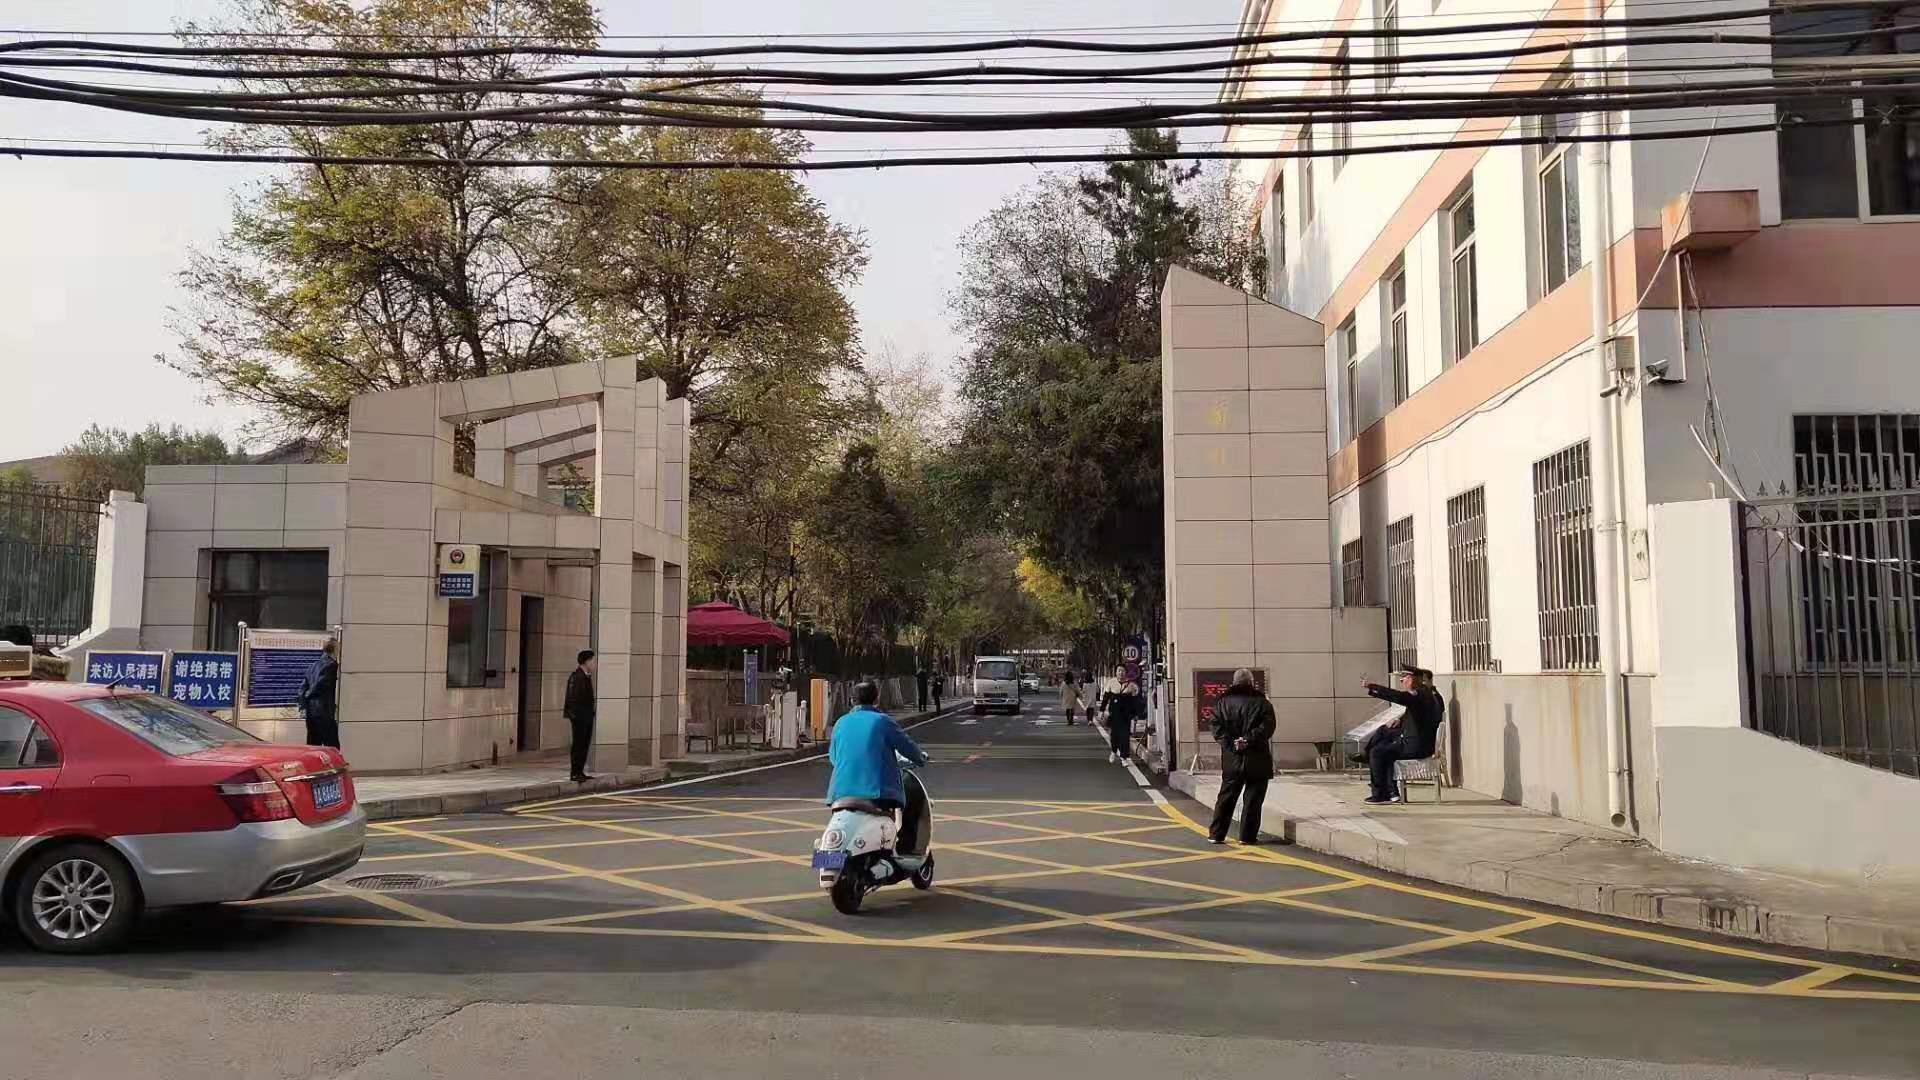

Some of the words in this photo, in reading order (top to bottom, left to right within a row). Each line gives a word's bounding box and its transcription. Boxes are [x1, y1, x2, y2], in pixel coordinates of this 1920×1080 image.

[1126, 648, 1137, 659] 10
[90, 663, 158, 680] 来访人员请到
[175, 660, 233, 679] 谢绝携带
[173, 684, 231, 701] 宠物入校
